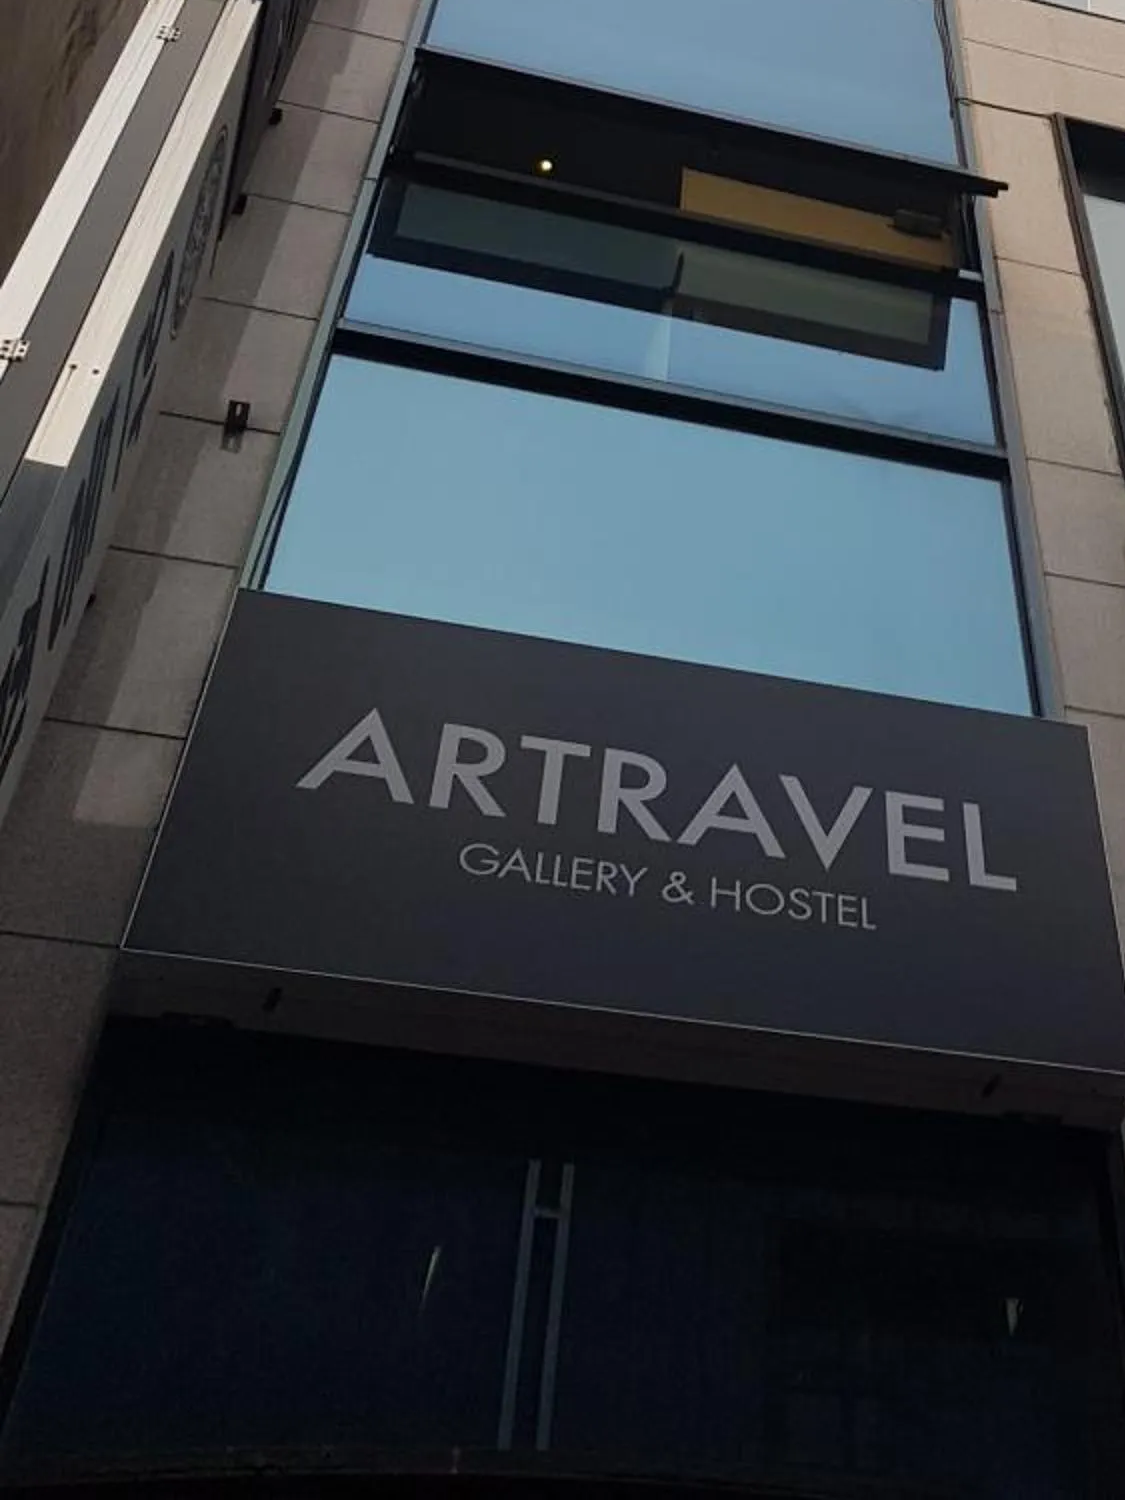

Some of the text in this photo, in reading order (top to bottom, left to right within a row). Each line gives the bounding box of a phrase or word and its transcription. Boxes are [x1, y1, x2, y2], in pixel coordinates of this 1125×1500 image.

[295, 706, 1018, 893] ARTRAVEL
[458, 842, 878, 930] GALLERY & HOSTEL
